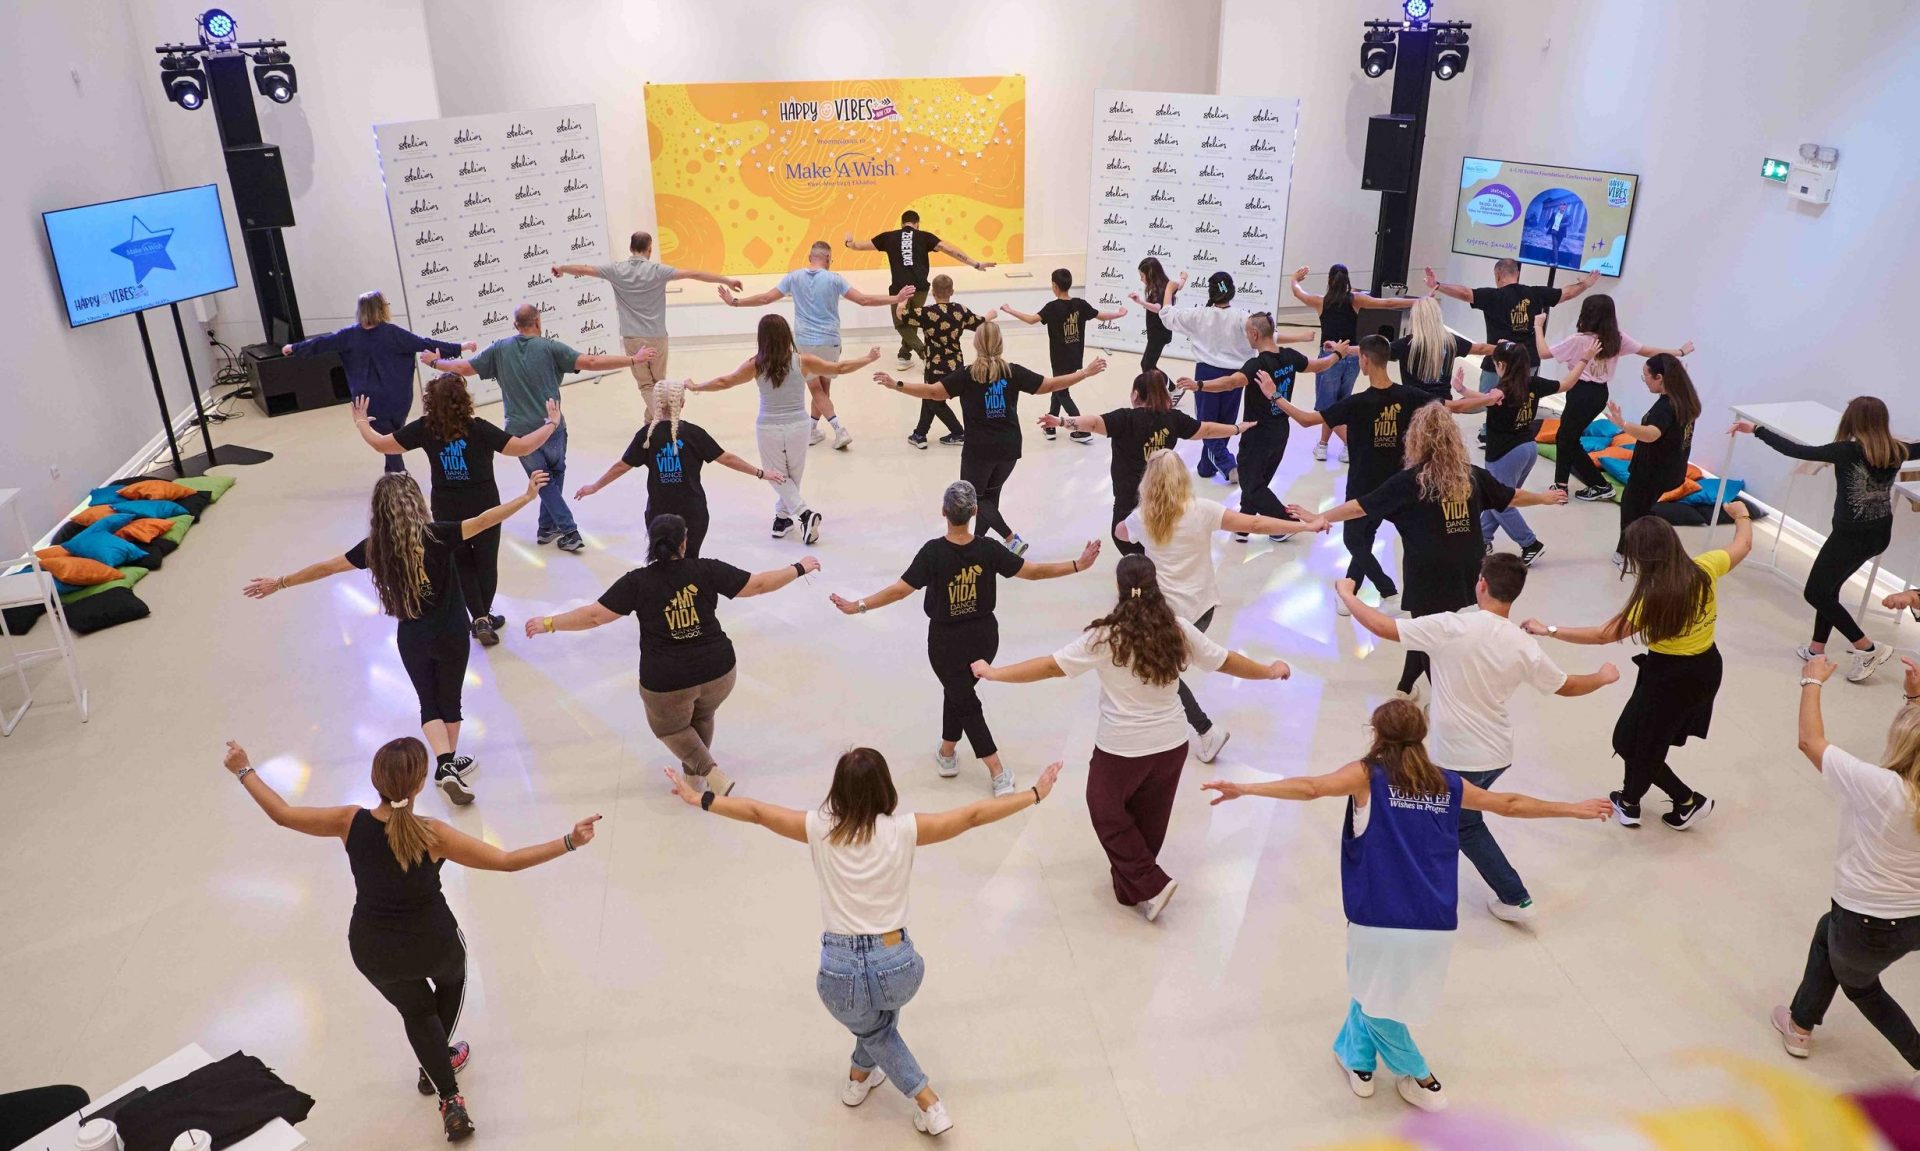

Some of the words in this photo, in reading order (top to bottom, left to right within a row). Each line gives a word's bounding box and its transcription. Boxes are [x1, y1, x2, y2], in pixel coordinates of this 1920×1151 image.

[780, 101, 818, 121] HAPPY
[835, 98, 873, 121] VIBES
[786, 162, 831, 179] Make
[852, 157, 895, 177] Wish
[74, 295, 100, 311] HAPPY
[109, 286, 135, 304] VIBES
[545, 329, 559, 339] lios
[984, 394, 1006, 409] VIDA
[1374, 420, 1397, 436] VIDA
[440, 455, 468, 472] VIDA
[656, 456, 682, 473] VIDA
[1441, 500, 1469, 521] VIDA
[1446, 519, 1470, 528] DANCE
[1446, 526, 1471, 534] SCHOOL
[948, 583, 977, 604] VIDA
[950, 600, 977, 611] DANCE
[950, 606, 977, 617] SCHOOL
[664, 606, 700, 630] VIDA
[1390, 800, 1415, 810] Wishes
[1416, 803, 1423, 811] in
